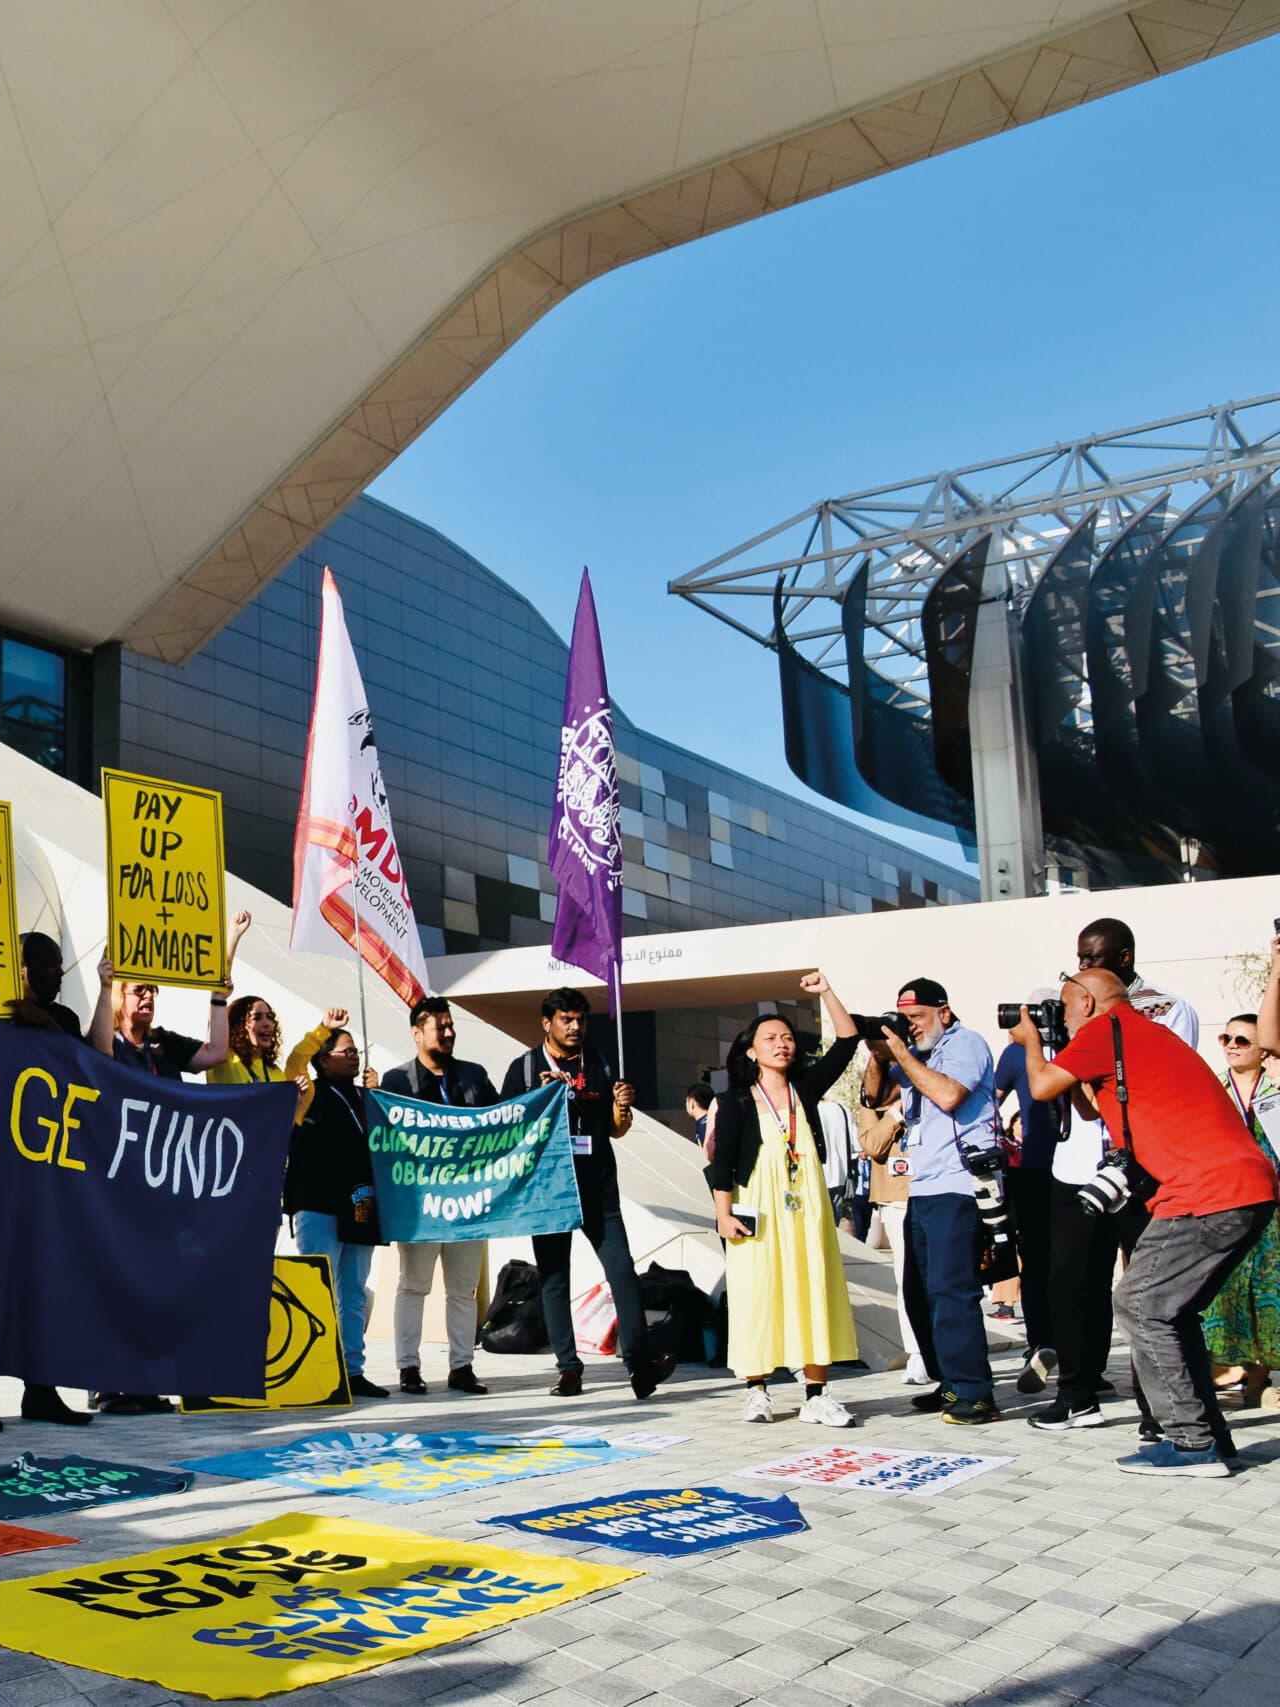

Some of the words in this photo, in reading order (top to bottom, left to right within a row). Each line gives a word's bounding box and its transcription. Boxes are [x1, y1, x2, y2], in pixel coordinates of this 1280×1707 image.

[133, 790, 182, 825] PAY
[140, 826, 183, 861] UP
[119, 862, 156, 902] FOR
[161, 869, 209, 912] LOSS
[354, 877, 408, 940] VELOPMENT
[119, 922, 215, 977] DAMAGE
[369, 1125, 458, 1159] CLIMATE
[459, 1117, 552, 1158] FINANCE
[388, 1105, 475, 1129] DELIVER
[476, 1104, 526, 1126] YOUR
[106, 1098, 245, 1198] FUND
[392, 1151, 536, 1185] OBLIGATIONS
[422, 1188, 493, 1222] NOW!
[30, 1568, 182, 1603] NO
[163, 1543, 294, 1571] TO
[192, 1565, 496, 1647] CLIMATE
[246, 1576, 565, 1661] FINANCE
[270, 1585, 342, 1610] AS
